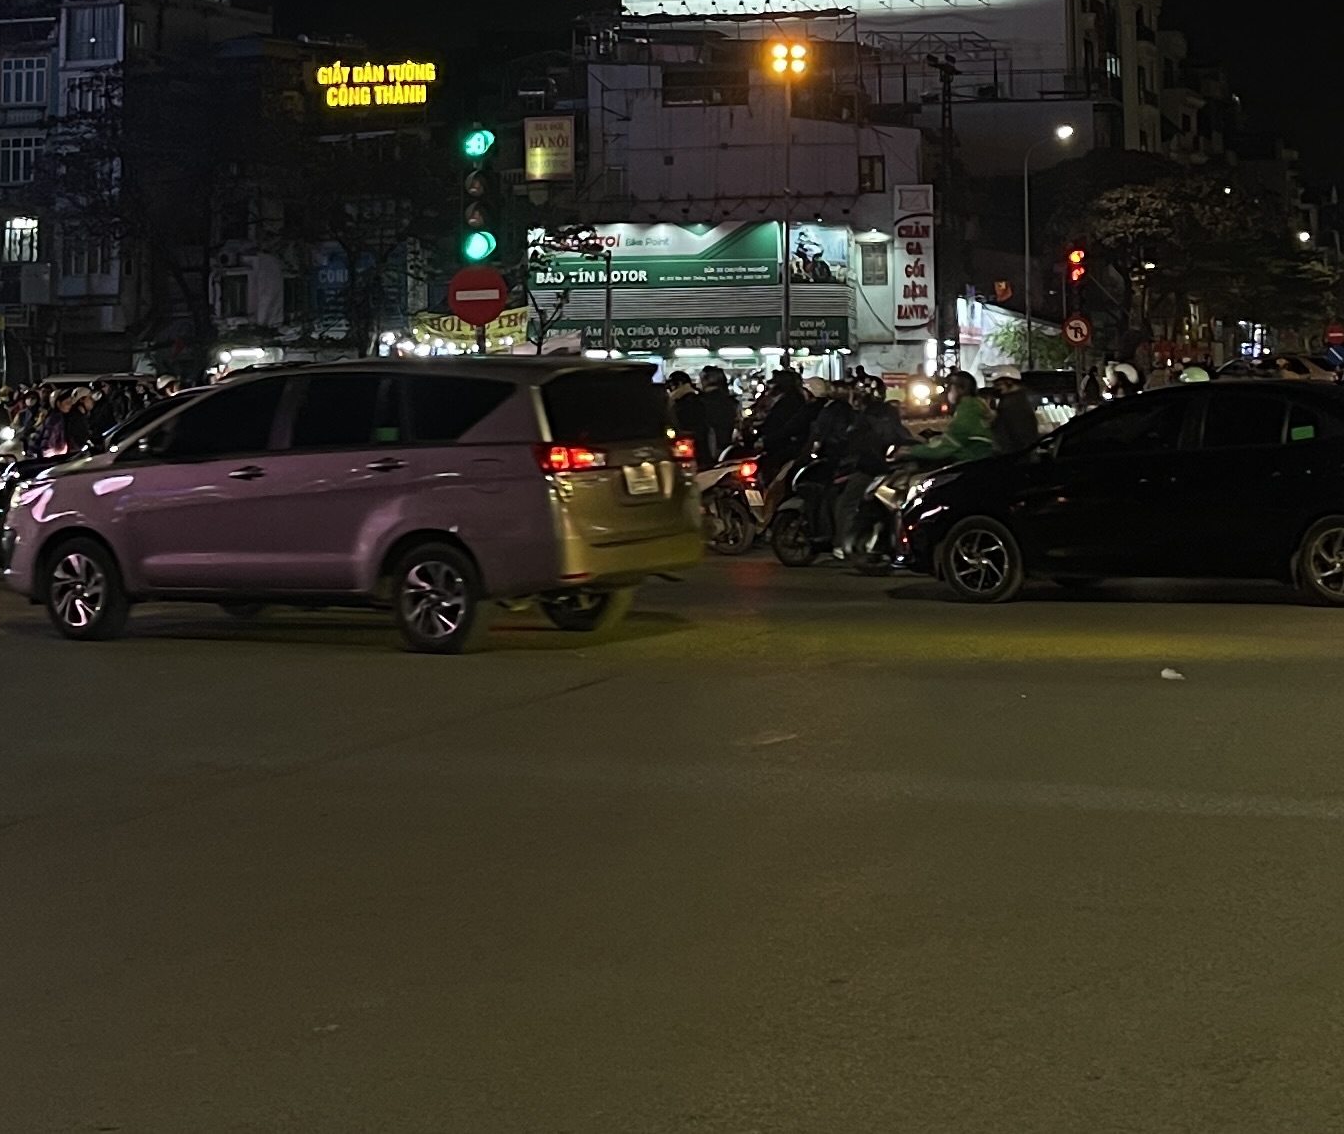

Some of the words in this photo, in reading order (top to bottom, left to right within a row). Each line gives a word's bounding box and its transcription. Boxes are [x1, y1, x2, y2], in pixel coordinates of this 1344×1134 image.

[316, 60, 351, 85] GIẤY
[352, 61, 385, 83] DÁN
[386, 59, 436, 82] TƯỜNG
[326, 83, 371, 107] CÔNG
[374, 81, 427, 105] THÀNH
[897, 221, 931, 239] CHĂN
[625, 237, 644, 247] Bike
[645, 237, 670, 246] Point
[905, 241, 923, 256] GA
[904, 258, 926, 278] GỐI
[627, 324, 655, 337] CHỮA
[657, 323, 681, 336] BẢO
[681, 323, 721, 335] DƯỠNG
[723, 325, 738, 335] XE
[739, 321, 762, 335] MÁY
[645, 338, 660, 348] SỐ
